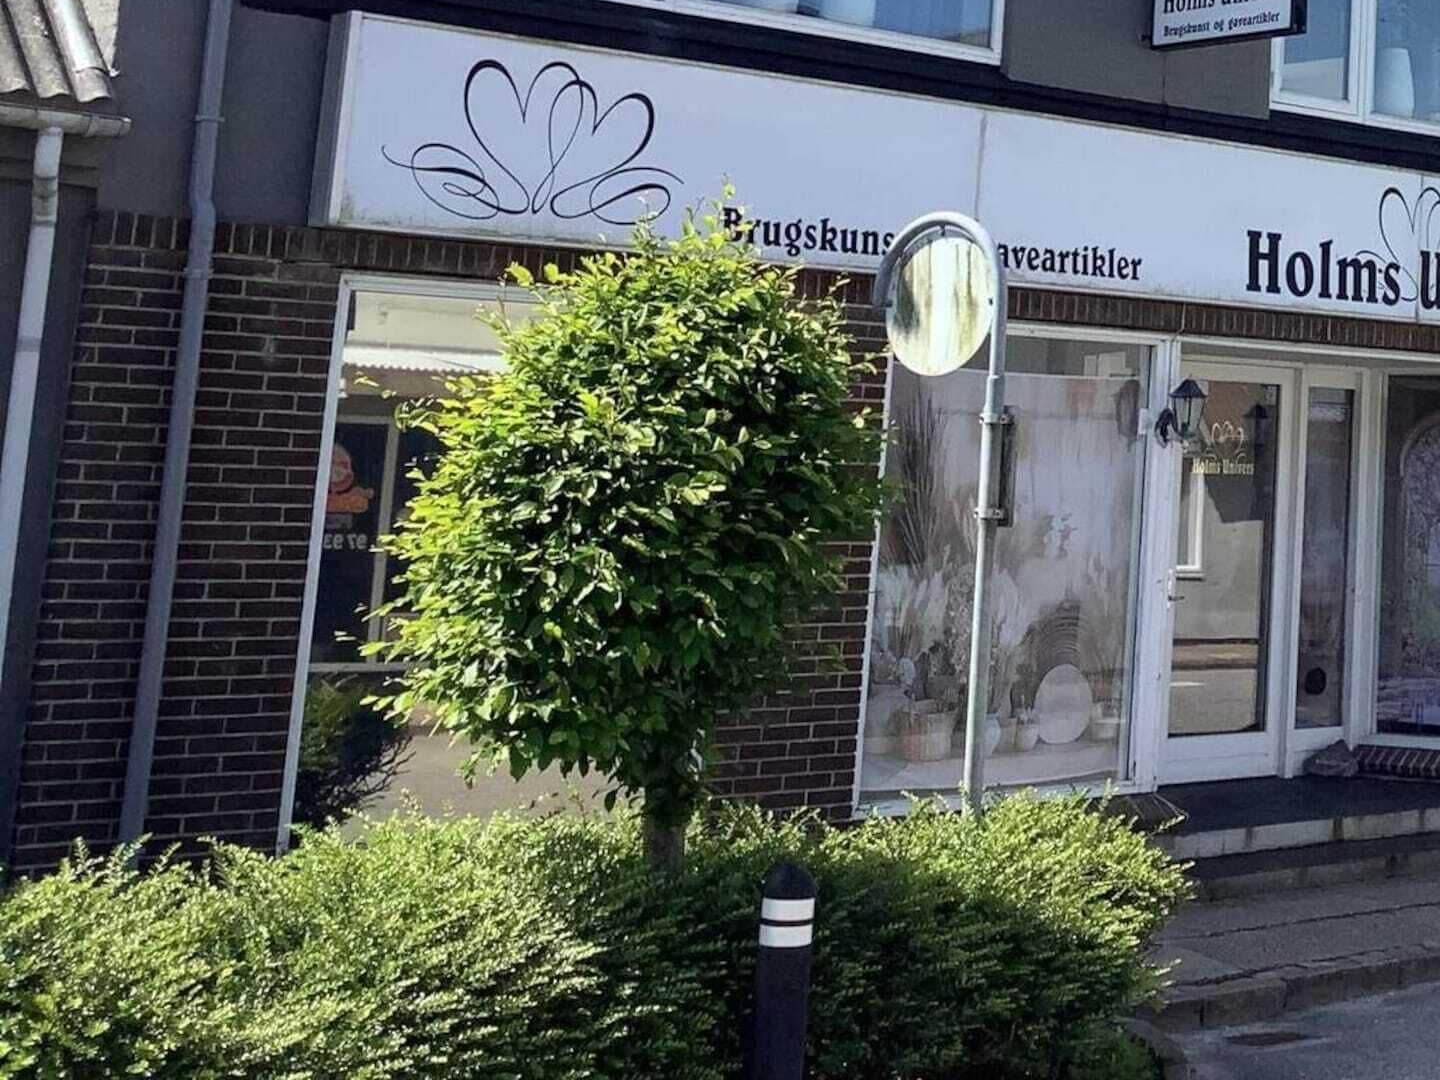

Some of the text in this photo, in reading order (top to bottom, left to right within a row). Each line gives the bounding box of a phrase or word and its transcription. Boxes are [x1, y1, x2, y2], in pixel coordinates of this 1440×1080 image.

[1163, 11, 1281, 38] Brugskunst og gaveartikler
[722, 206, 1143, 281] Brugskuns aveartikler
[1245, 229, 1402, 307] Holms
